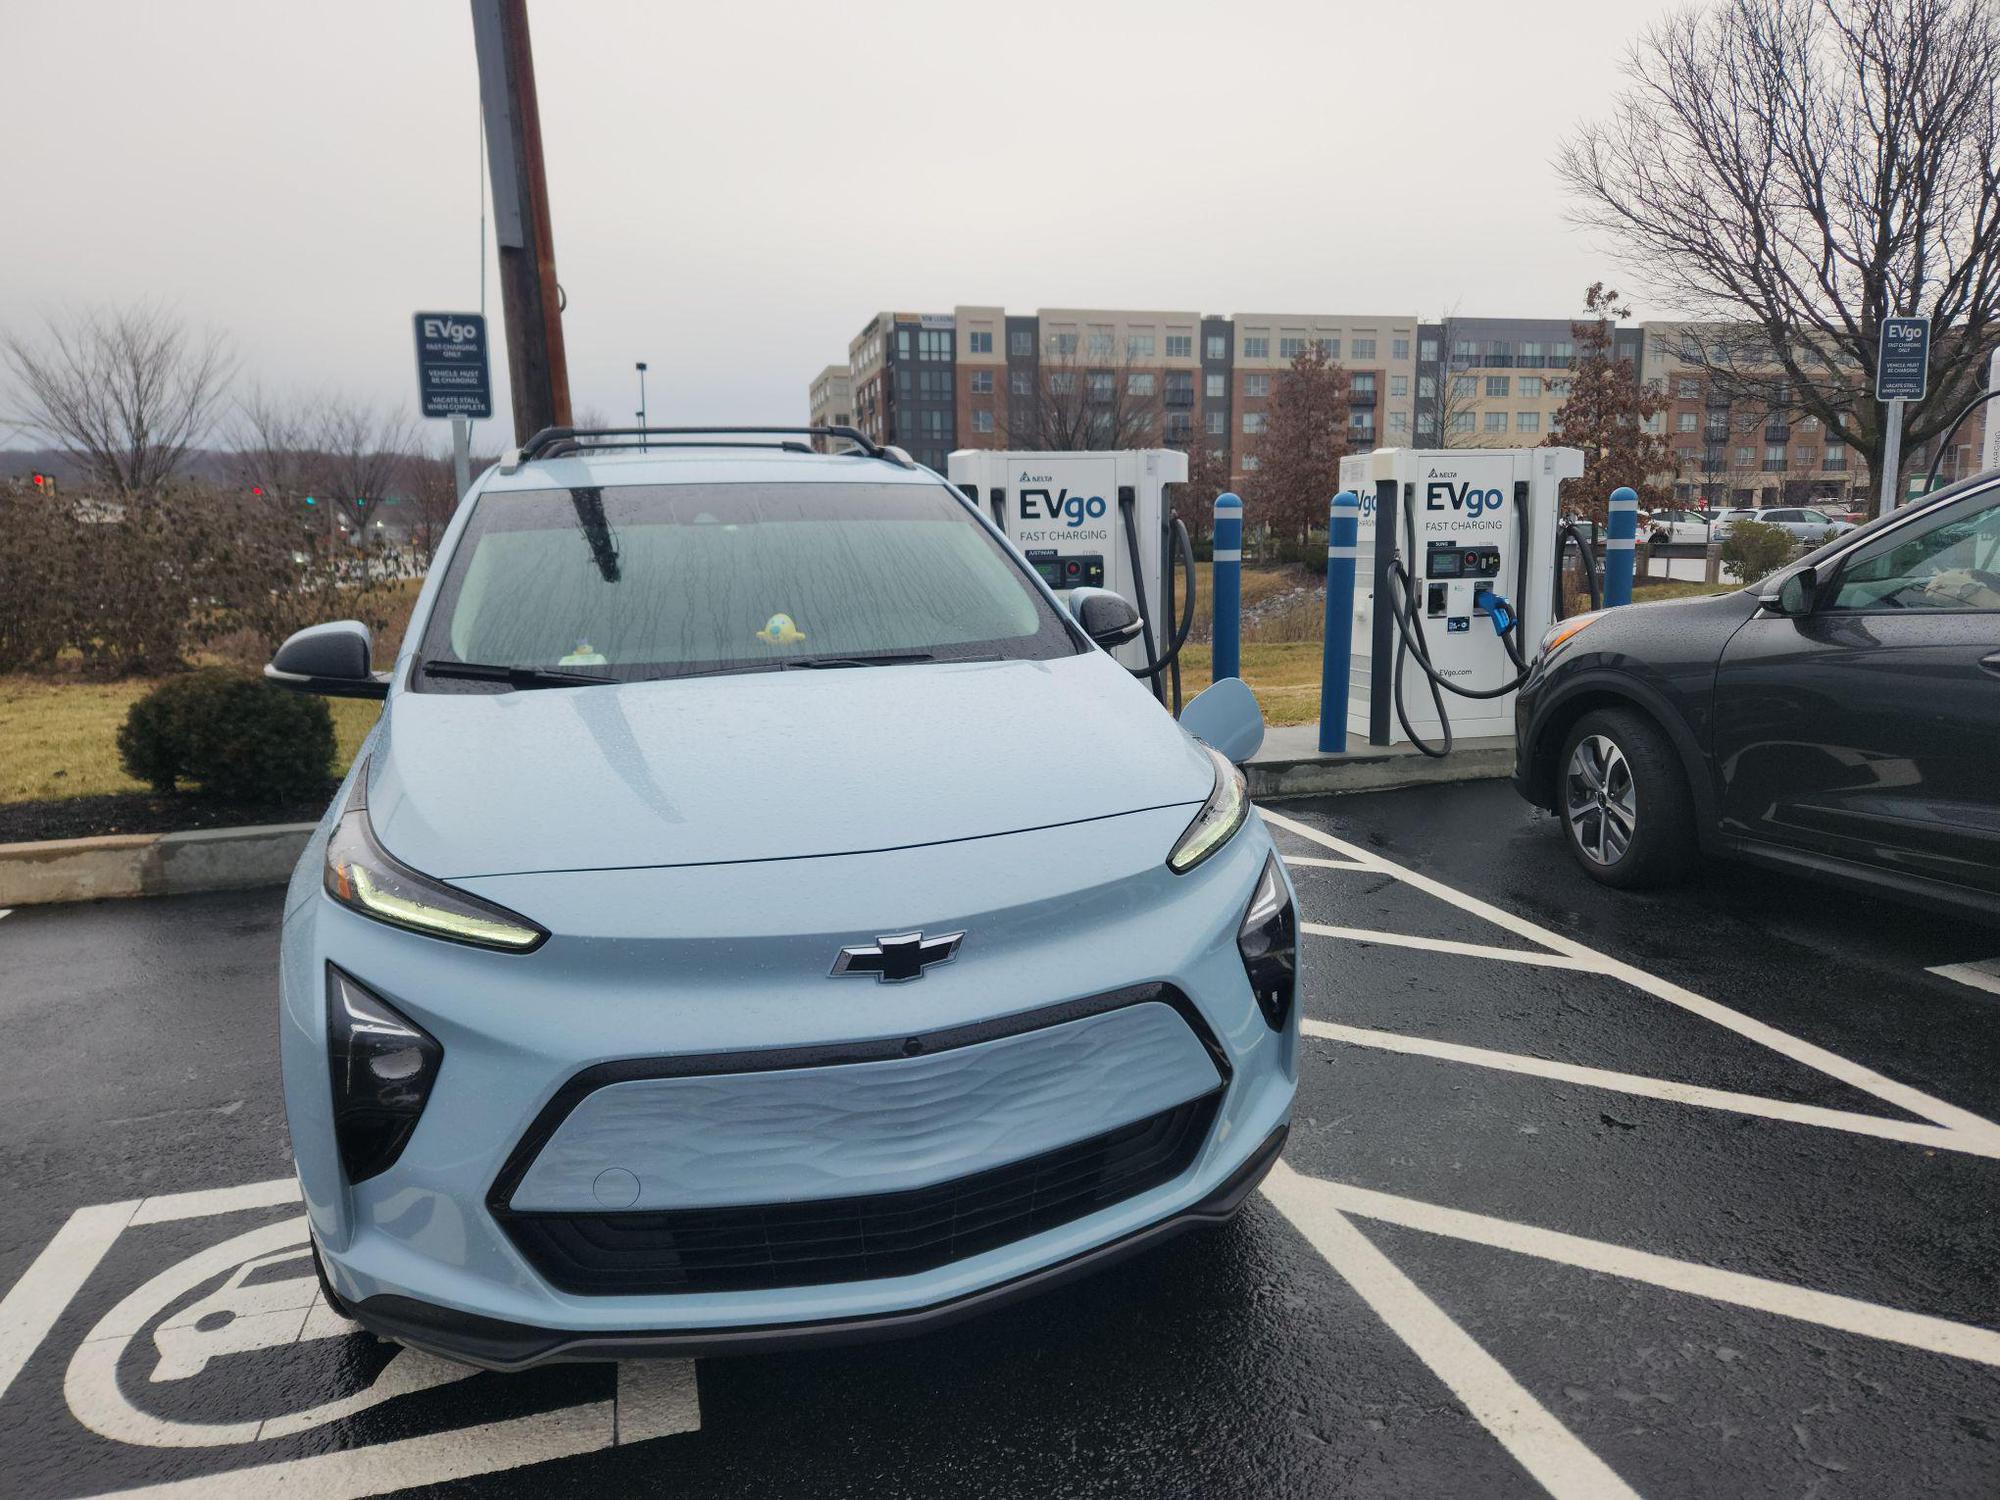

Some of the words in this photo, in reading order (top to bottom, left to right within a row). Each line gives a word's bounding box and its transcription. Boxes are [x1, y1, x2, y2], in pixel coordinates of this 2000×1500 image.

[424, 319, 476, 342] EVgo
[1889, 325, 1922, 341] EVgo
[1020, 488, 1106, 527] EVgo
[1427, 482, 1503, 518] EVgo
[1425, 522, 1449, 531] FAST
[1451, 520, 1503, 530] CHARGING
[1020, 531, 1046, 541] FAST
[1049, 529, 1107, 540] CHARGING
[1440, 669, 1473, 677] EVgo.com
